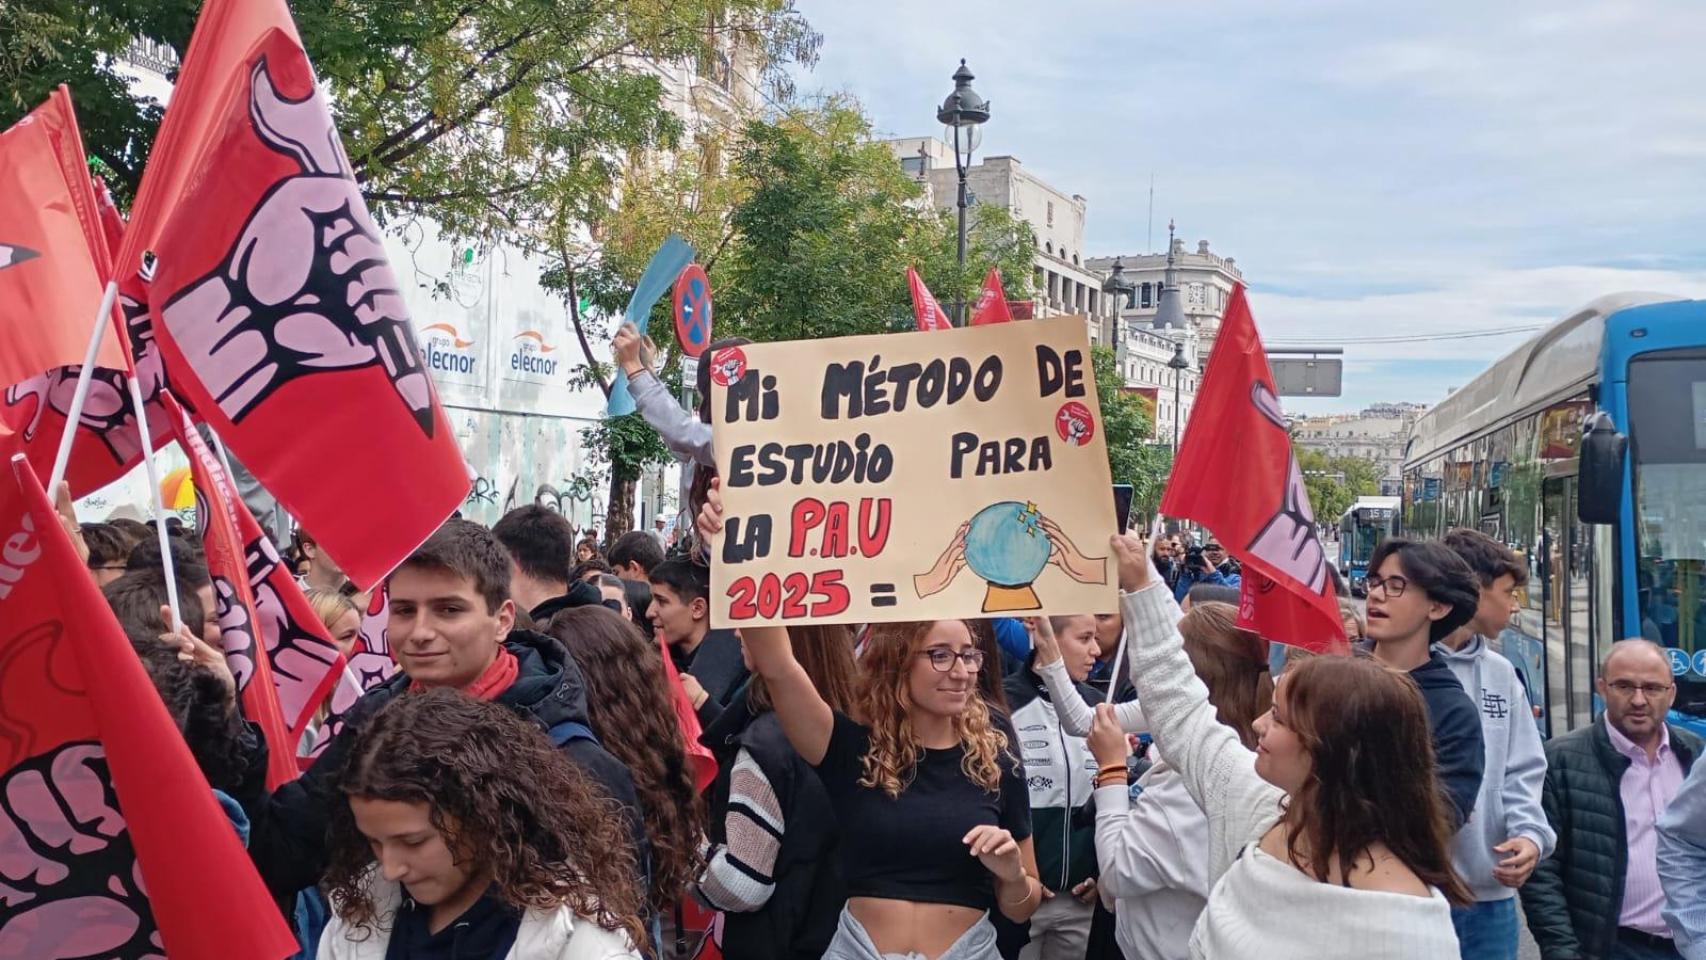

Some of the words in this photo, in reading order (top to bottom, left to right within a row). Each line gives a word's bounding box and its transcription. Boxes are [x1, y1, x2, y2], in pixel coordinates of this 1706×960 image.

[511, 347, 558, 376] elecnor
[821, 354, 1004, 420] MÉTODO
[1035, 344, 1086, 398] DE
[950, 432, 1052, 479] PARA
[722, 514, 772, 564] LA
[788, 497, 892, 558] P.A.U
[726, 569, 851, 620] 2025
